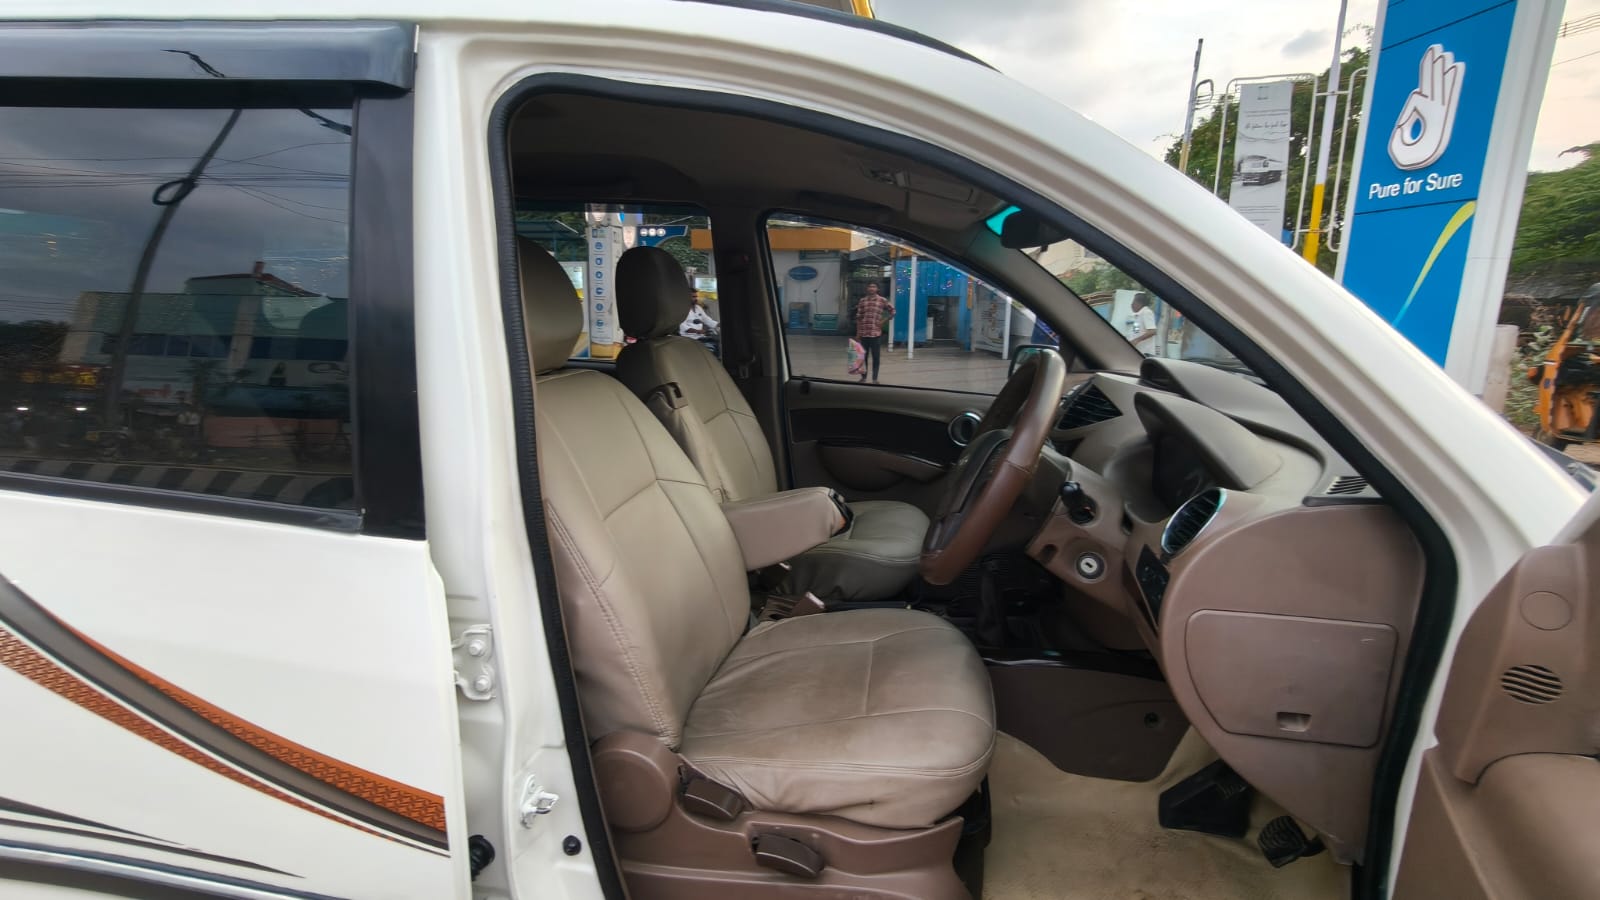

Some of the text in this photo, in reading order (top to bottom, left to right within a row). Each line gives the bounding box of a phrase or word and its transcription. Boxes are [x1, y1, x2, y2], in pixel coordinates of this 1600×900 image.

[1368, 173, 1463, 200] Pure for Sure
